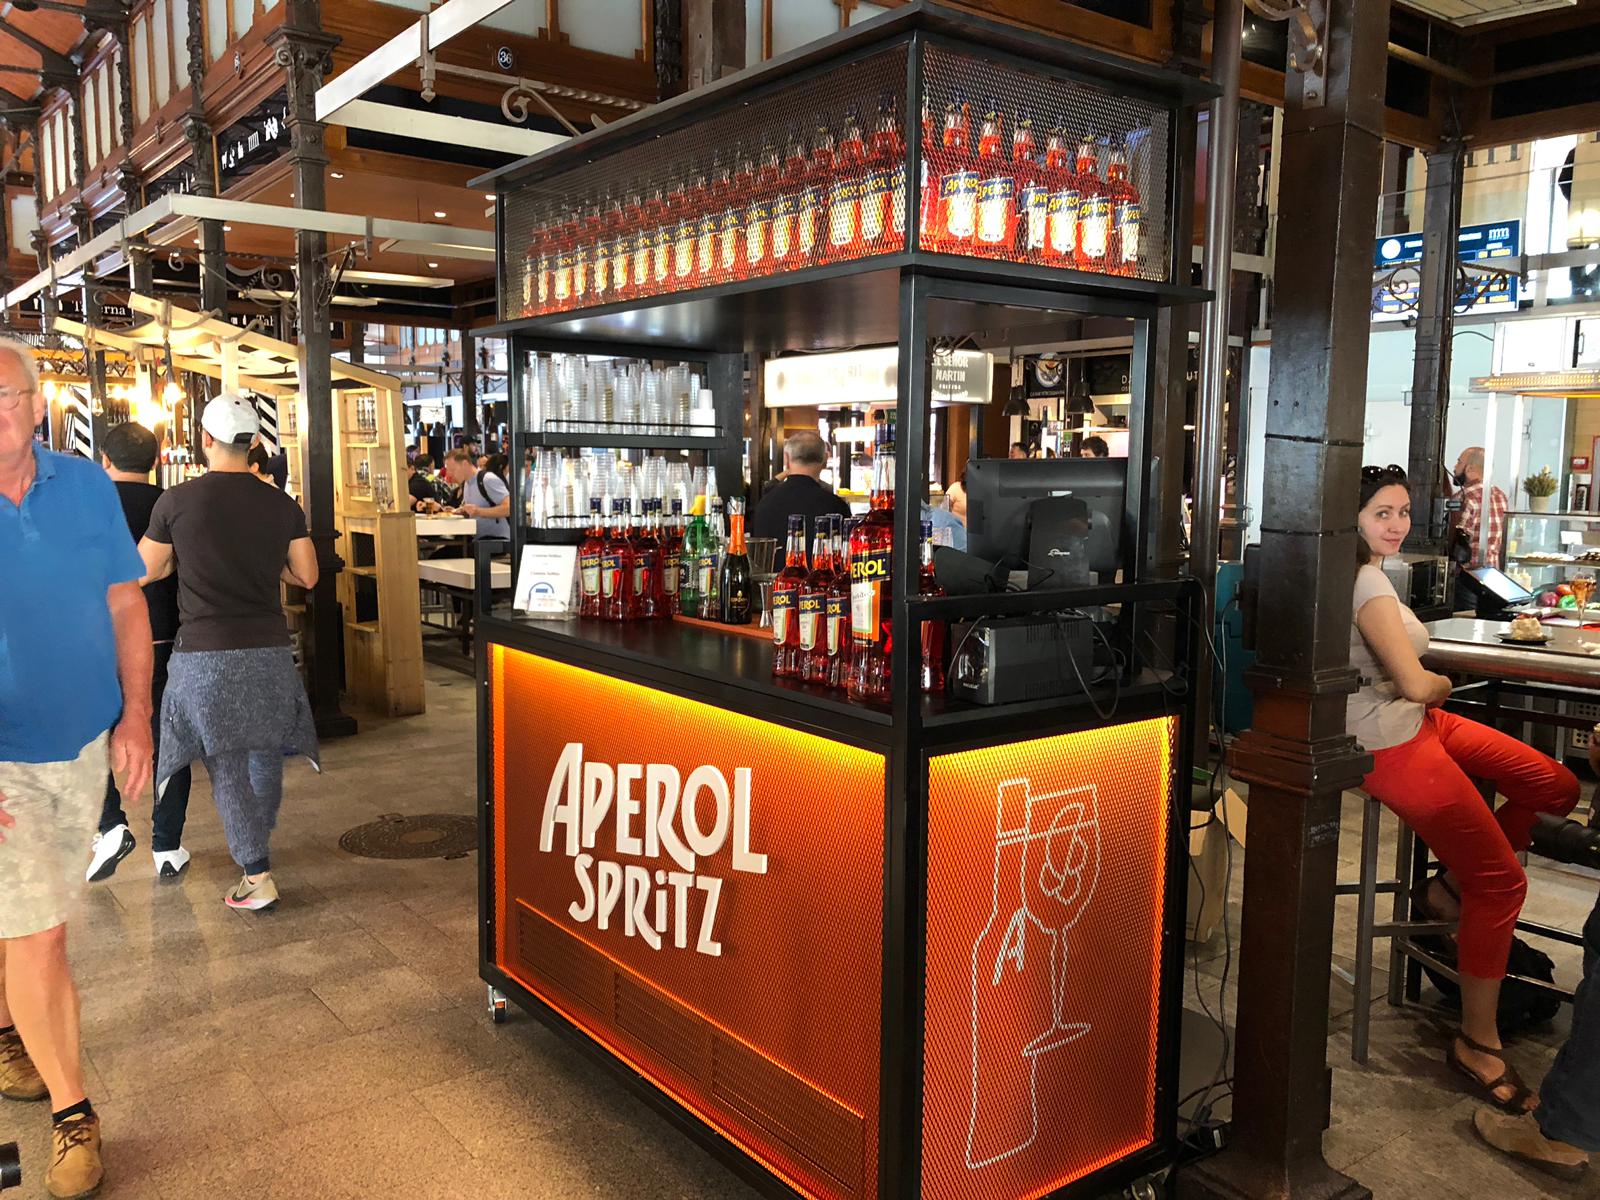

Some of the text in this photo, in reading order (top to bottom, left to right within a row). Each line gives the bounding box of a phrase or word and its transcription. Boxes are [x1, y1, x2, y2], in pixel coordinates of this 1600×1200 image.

[935, 368, 966, 382] MARTIN
[851, 558, 886, 578] EROL
[539, 743, 768, 874] APEROL
